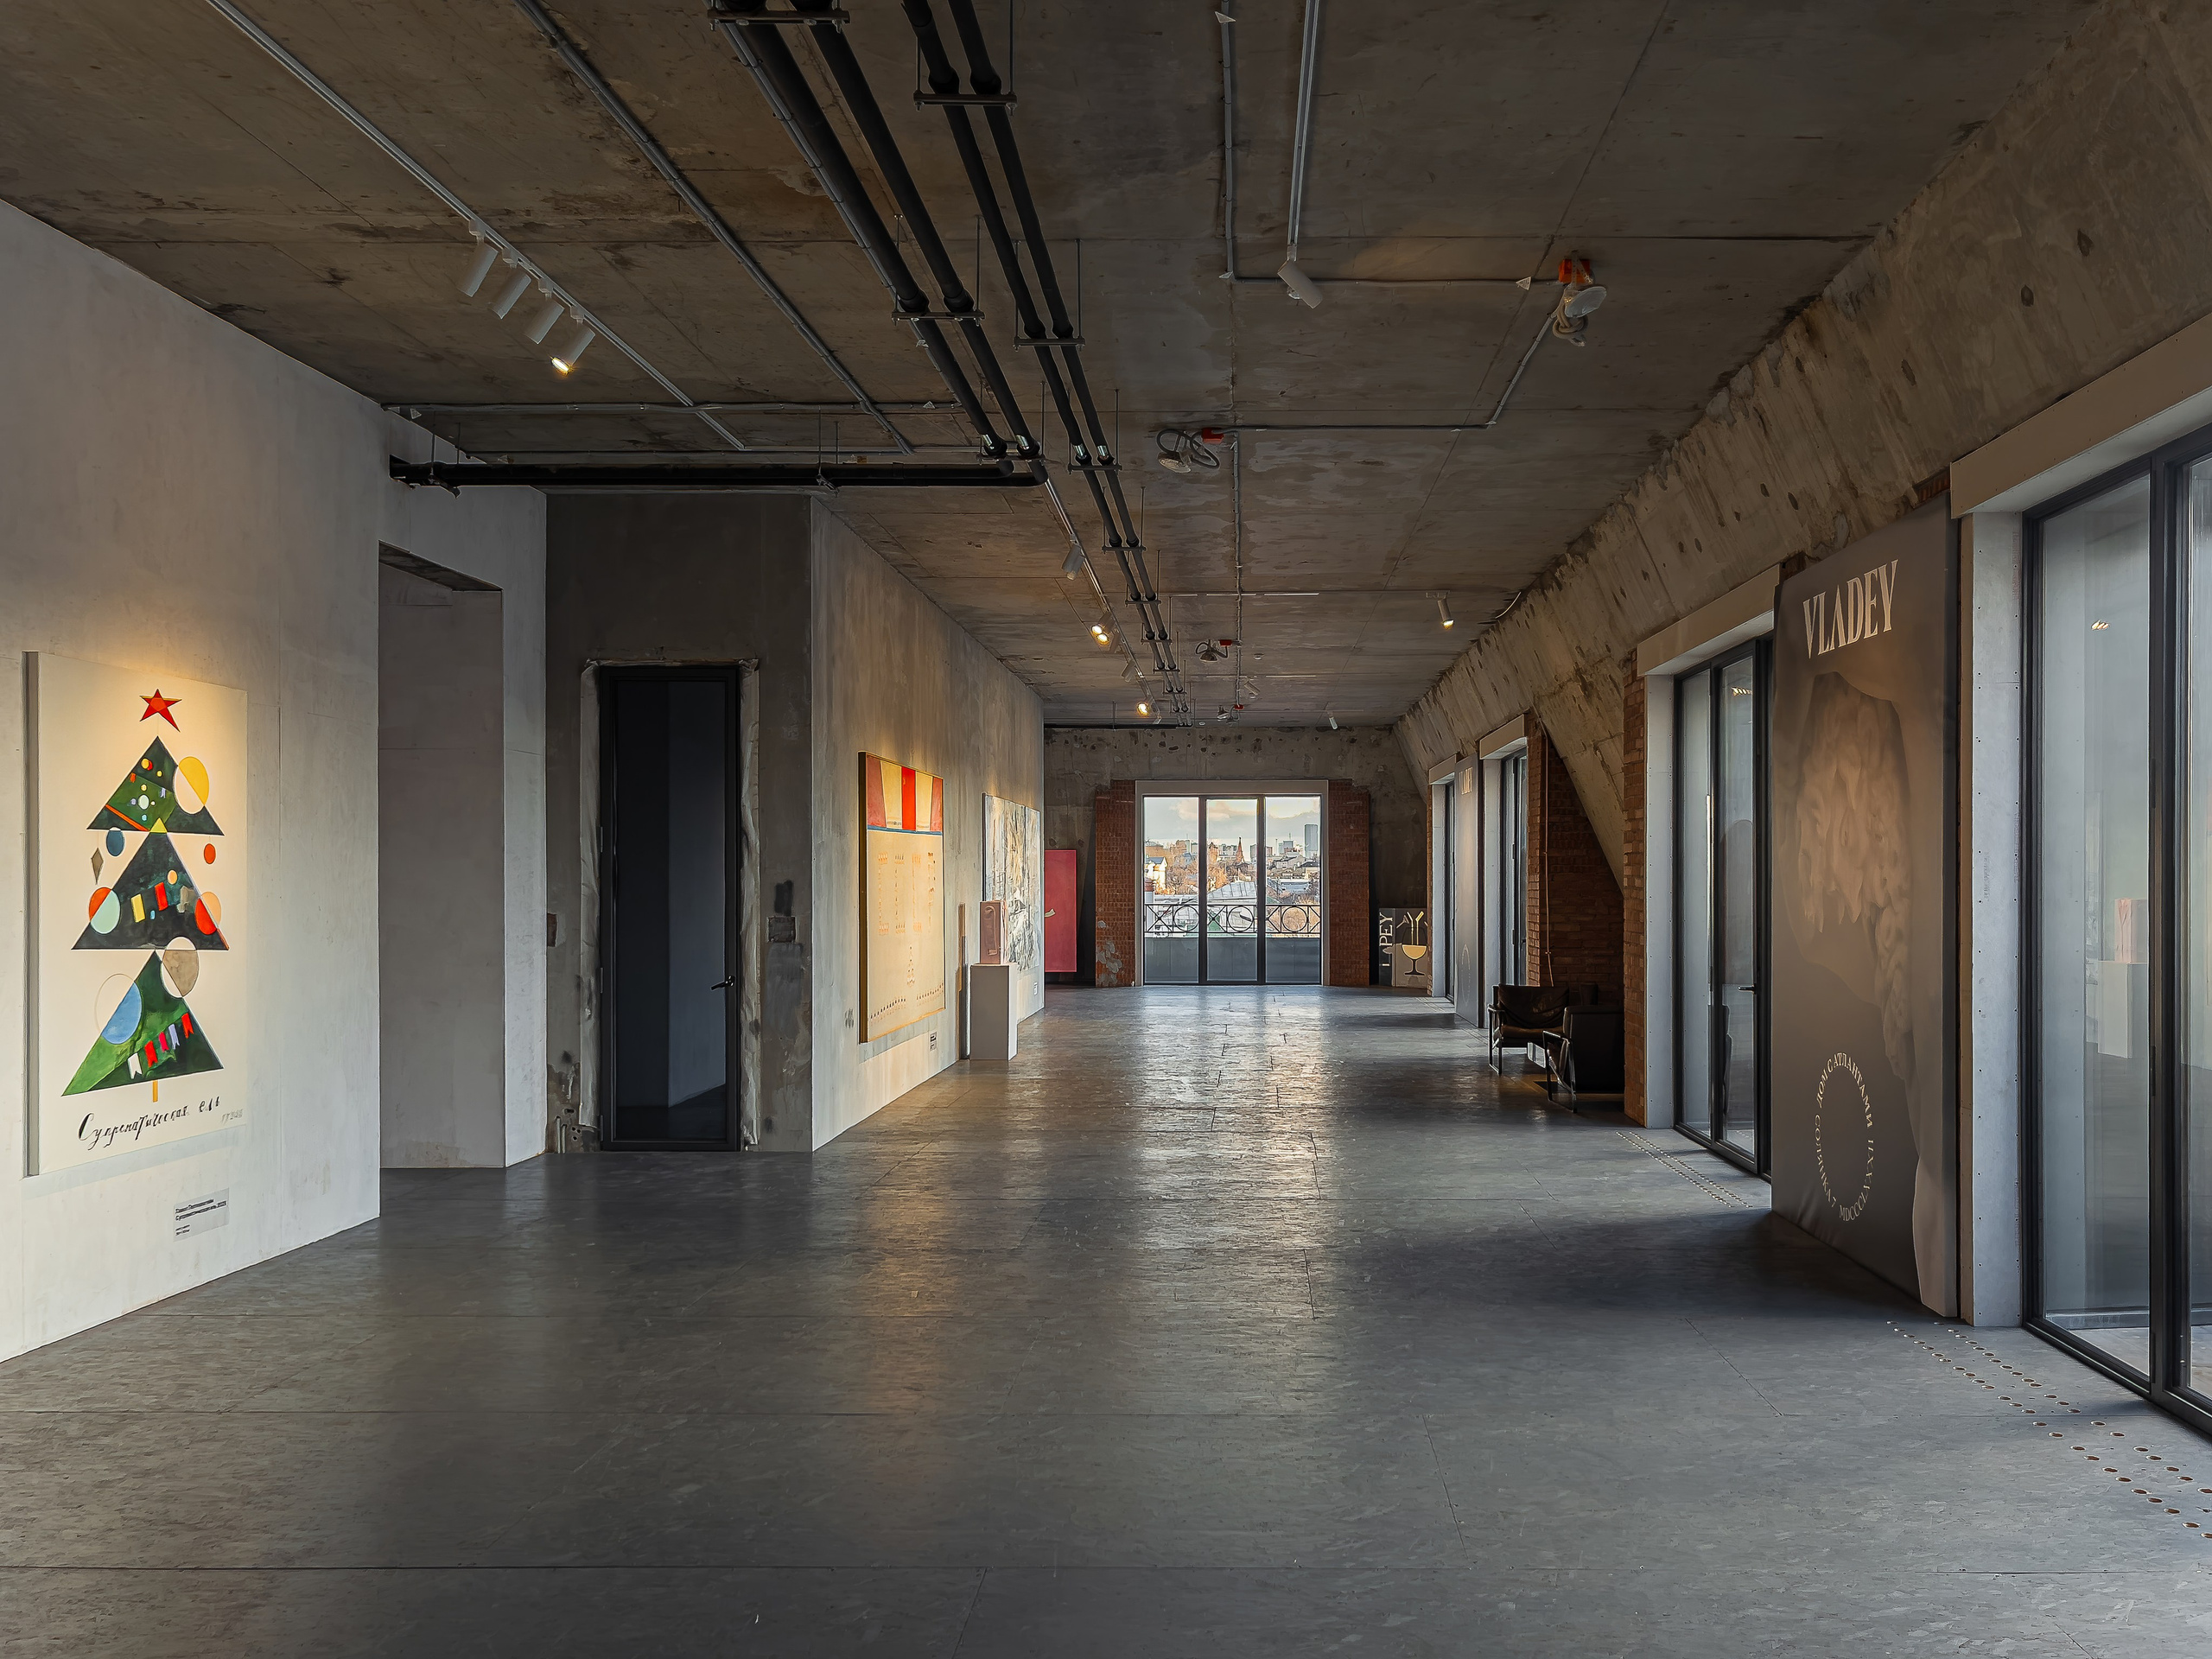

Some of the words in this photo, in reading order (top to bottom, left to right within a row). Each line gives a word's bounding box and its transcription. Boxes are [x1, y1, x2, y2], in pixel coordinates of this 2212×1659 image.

[1802, 559, 1898, 659] VLADEY
[1816, 1069, 1828, 1109] ДОМ
[1827, 1058, 1834, 1073] С
[1833, 1052, 1873, 1128] АТЛАНТАМИ
